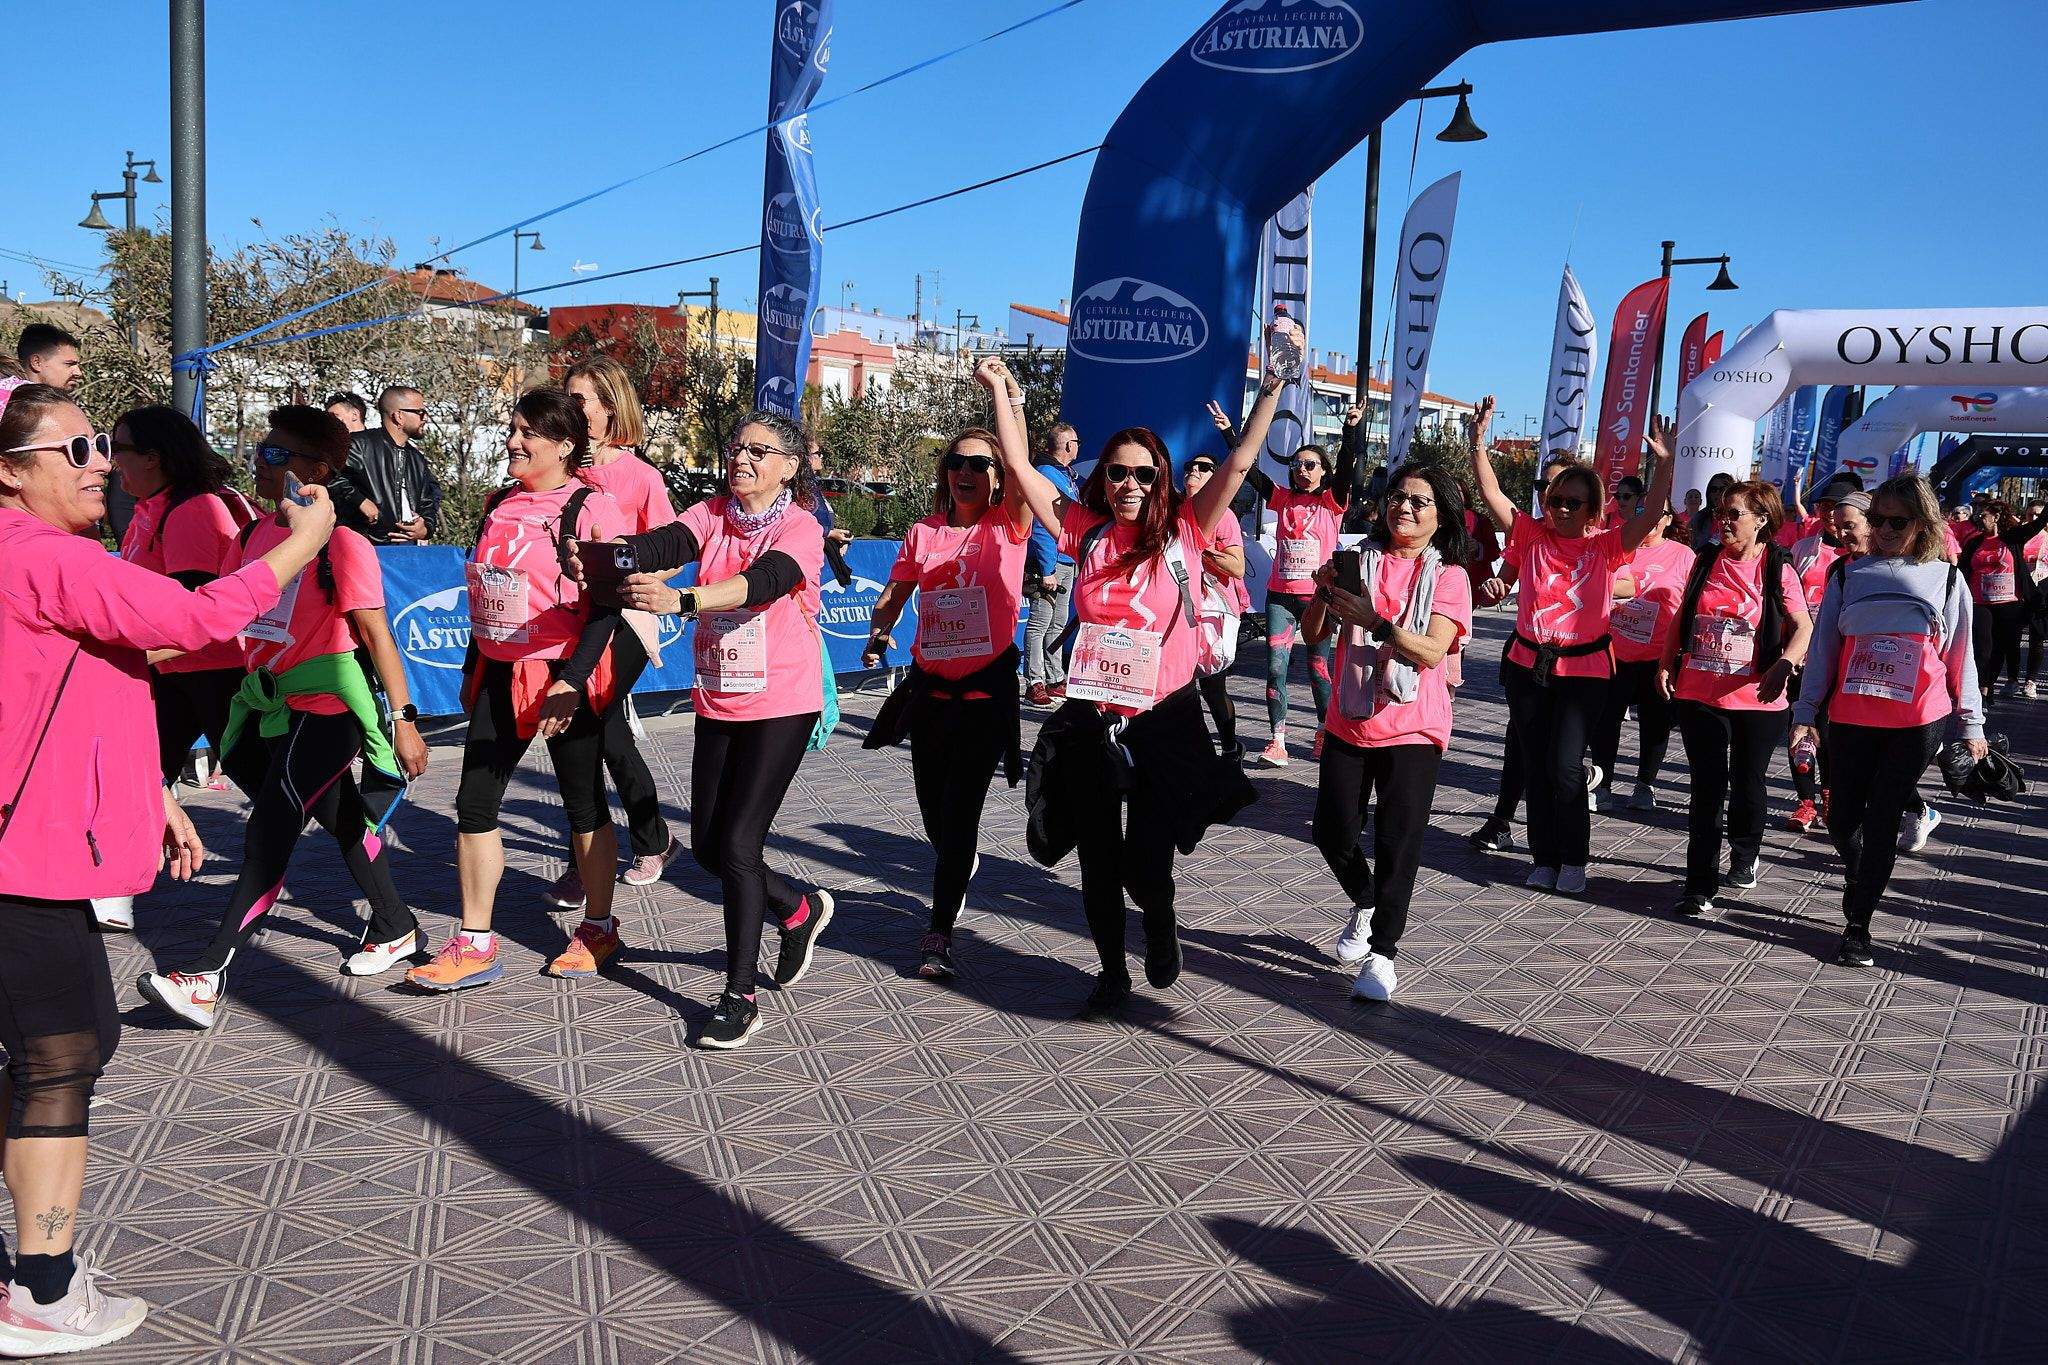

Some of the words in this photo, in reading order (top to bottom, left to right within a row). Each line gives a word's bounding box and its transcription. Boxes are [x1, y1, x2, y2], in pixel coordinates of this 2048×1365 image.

[1228, 12, 1279, 27] CENTRAL
[1284, 11, 1344, 21] LECHERA
[1198, 26, 1348, 55] ASTURIANA
[1086, 306, 1130, 315] CENTRAL
[1136, 308, 1192, 320] LECHERA
[1071, 309, 1195, 346] ASTURIANA
[1617, 310, 1650, 412] Santander
[1713, 370, 1773, 384] OYSHO
[1949, 415, 1998, 423] TotalEnergies
[1681, 445, 1735, 460] OYSHO
[483, 598, 504, 611] 016
[819, 600, 875, 624] ASTURI
[1621, 614, 1640, 624] 016
[940, 620, 966, 632] 016
[711, 647, 738, 661] 016
[1100, 660, 1131, 675] 016
[1867, 661, 1895, 674] 016
[1076, 688, 1103, 696] OYSHO
